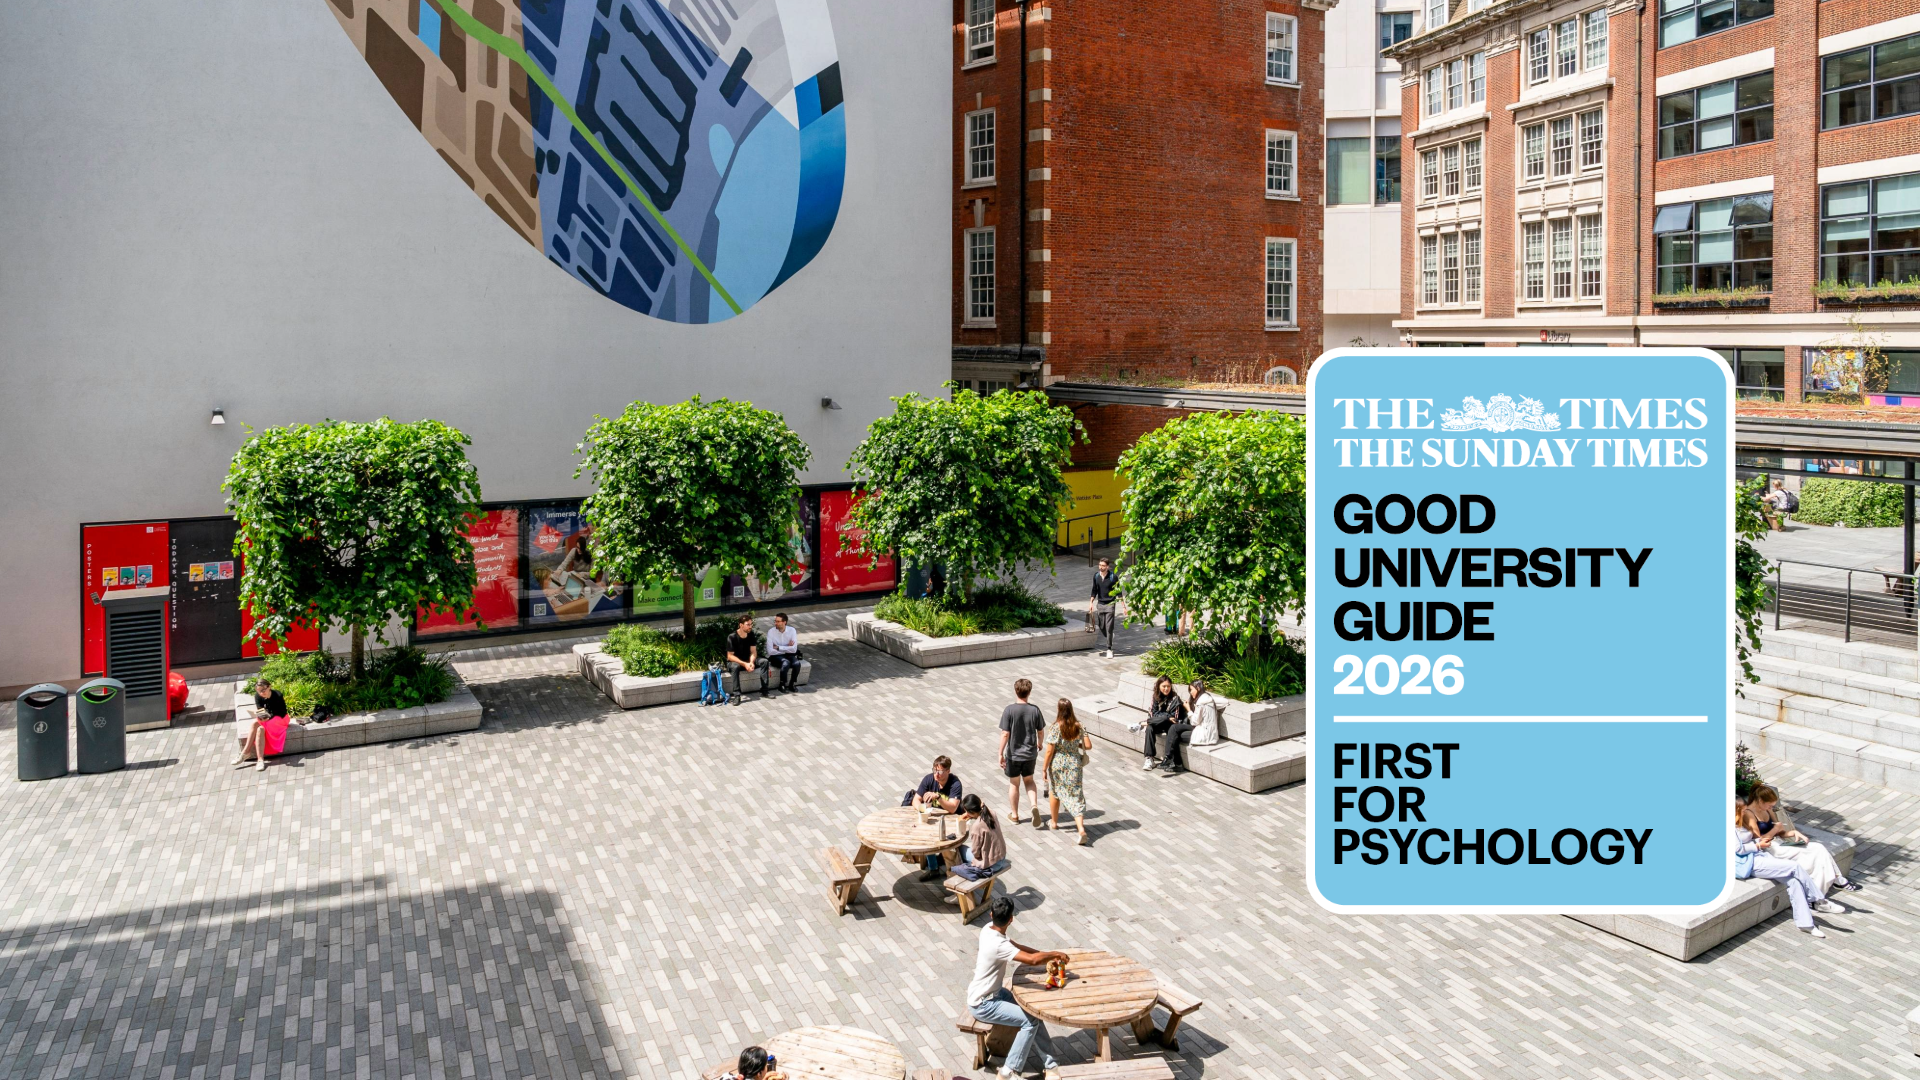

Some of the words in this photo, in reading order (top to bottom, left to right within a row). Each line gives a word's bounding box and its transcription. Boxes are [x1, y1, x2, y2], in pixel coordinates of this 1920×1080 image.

[1547, 330, 1571, 343] Library
[546, 510, 577, 518] Immerse
[637, 595, 656, 604] Make
[656, 594, 684, 602] connecti
